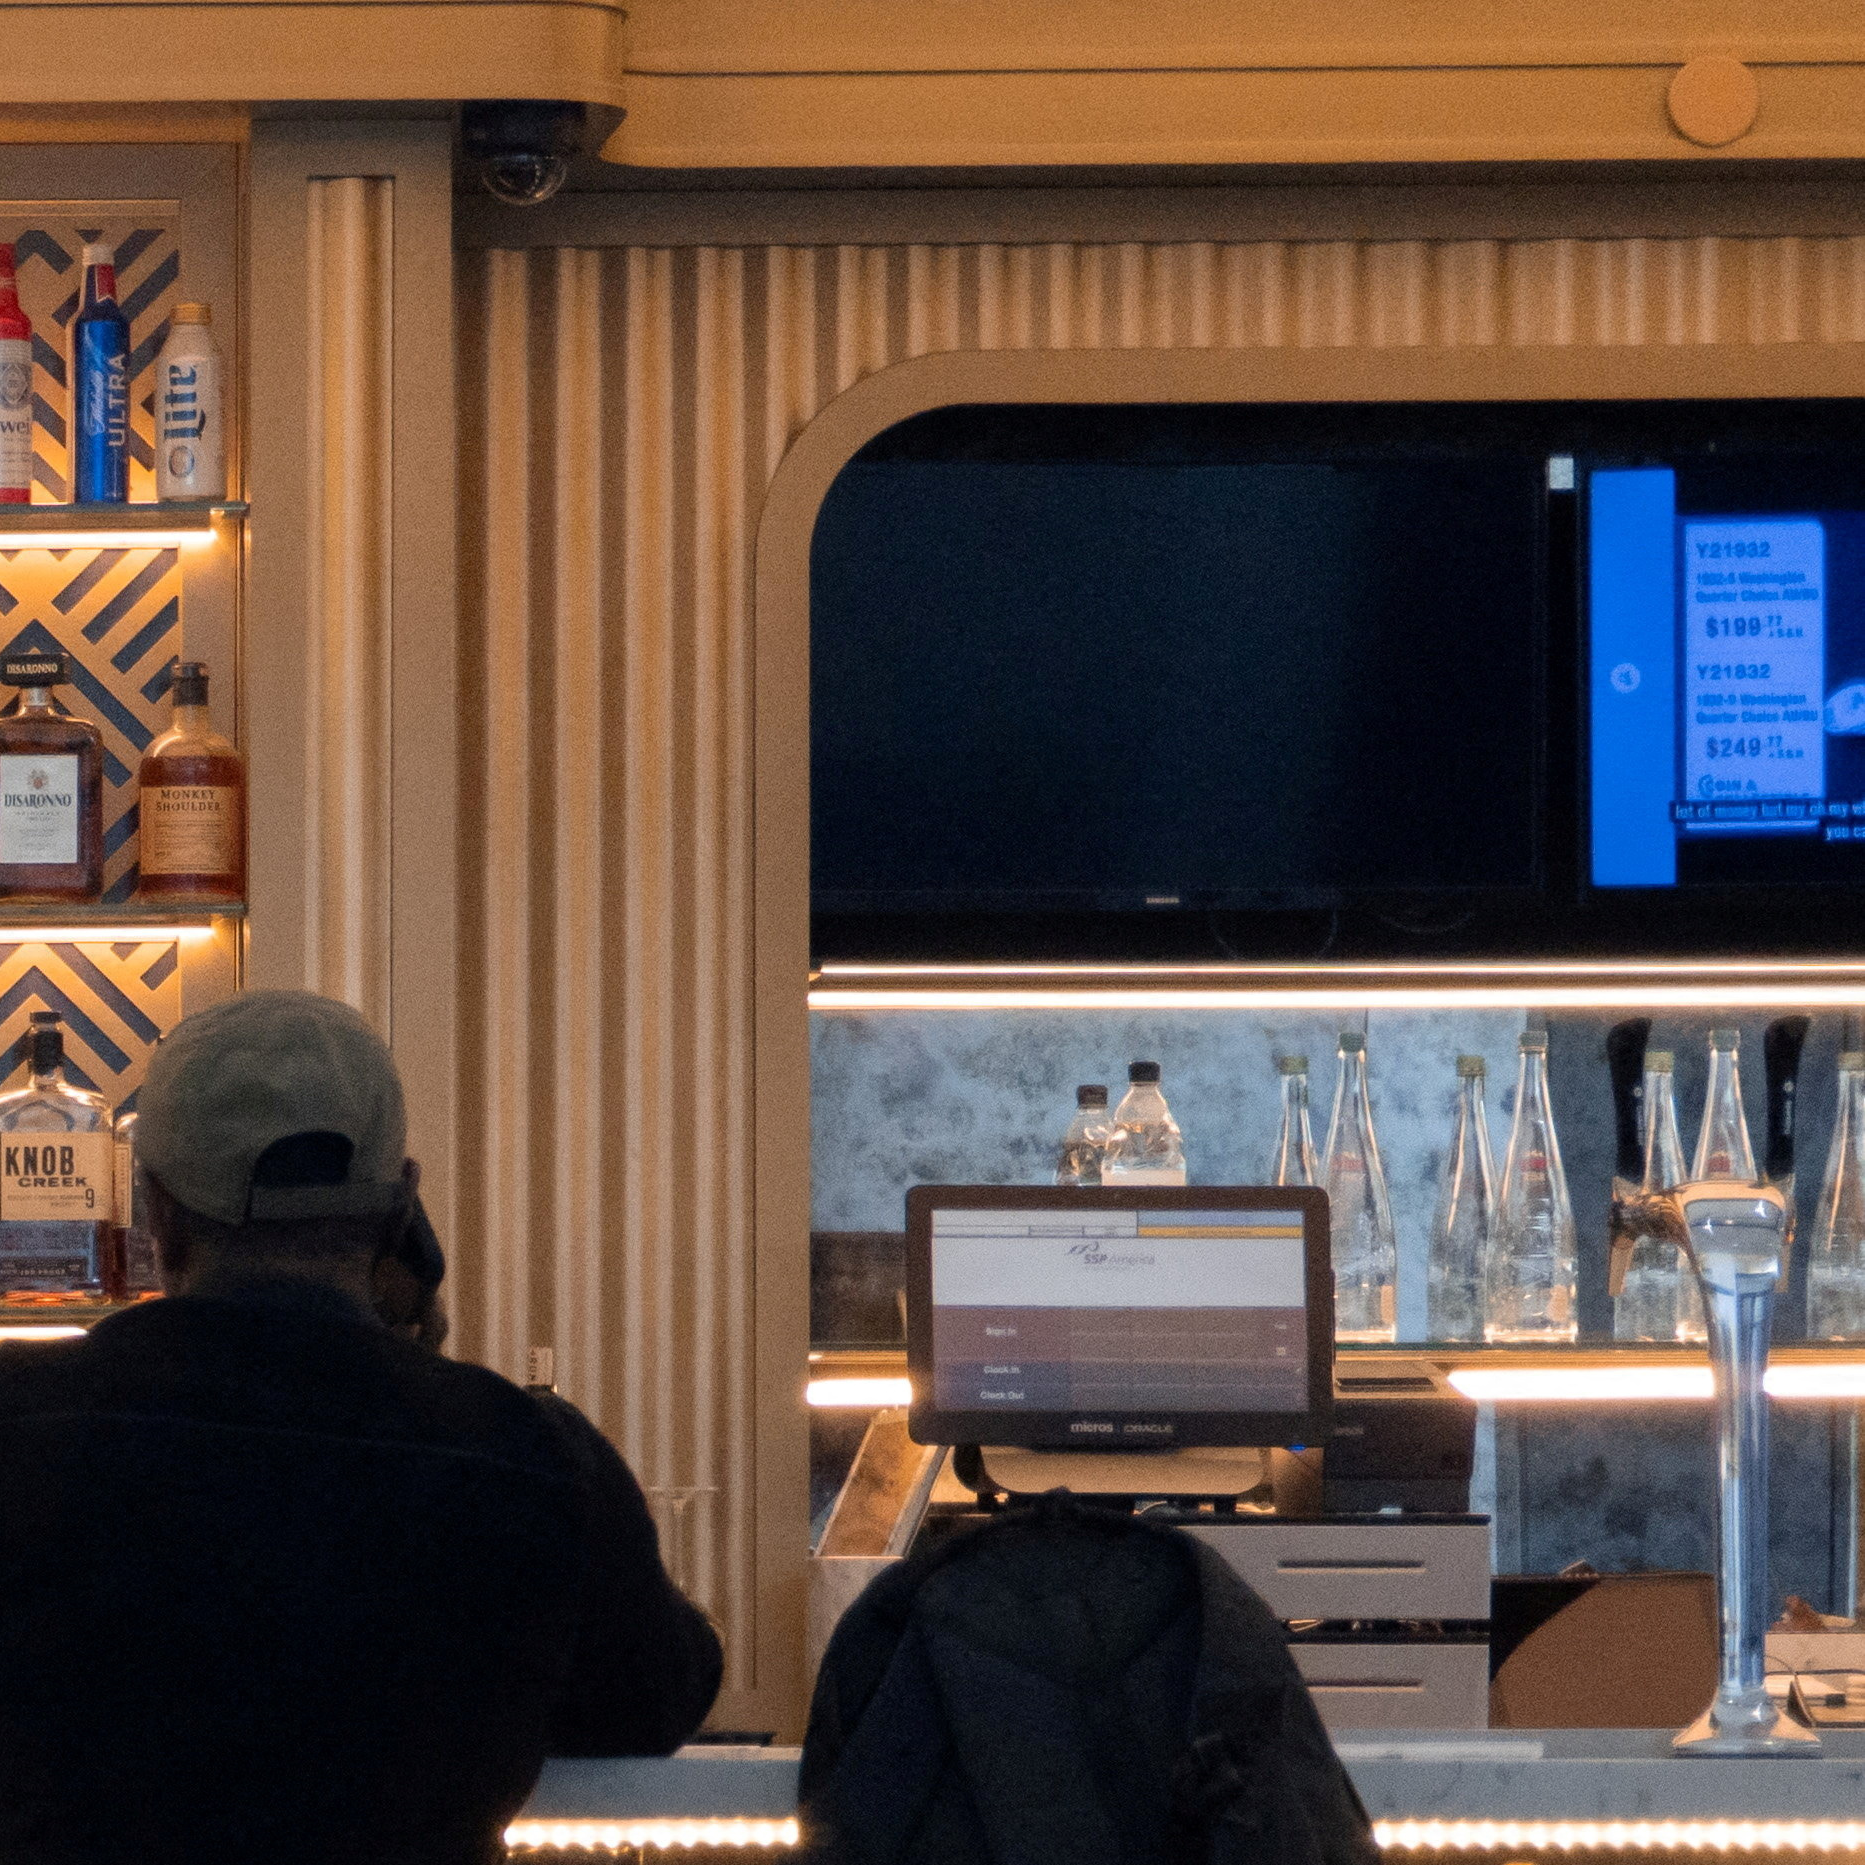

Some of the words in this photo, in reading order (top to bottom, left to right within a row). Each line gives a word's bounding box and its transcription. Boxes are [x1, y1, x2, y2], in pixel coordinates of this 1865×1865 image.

[107, 353, 126, 447] ULTRA
[164, 364, 207, 440] Lite
[6, 663, 58, 674] DISARONNO
[161, 789, 216, 799] MONKEY
[3, 793, 72, 809] DISARONNO
[156, 801, 220, 812] SHOULDER
[5, 1146, 75, 1176] KNOB
[17, 1177, 88, 1188] CREEK
[84, 1188, 95, 1209] 9
[1084, 1254, 1108, 1265] SSP
[1070, 1421, 1114, 1432] micros
[1123, 1424, 1173, 1433] ORACLE
